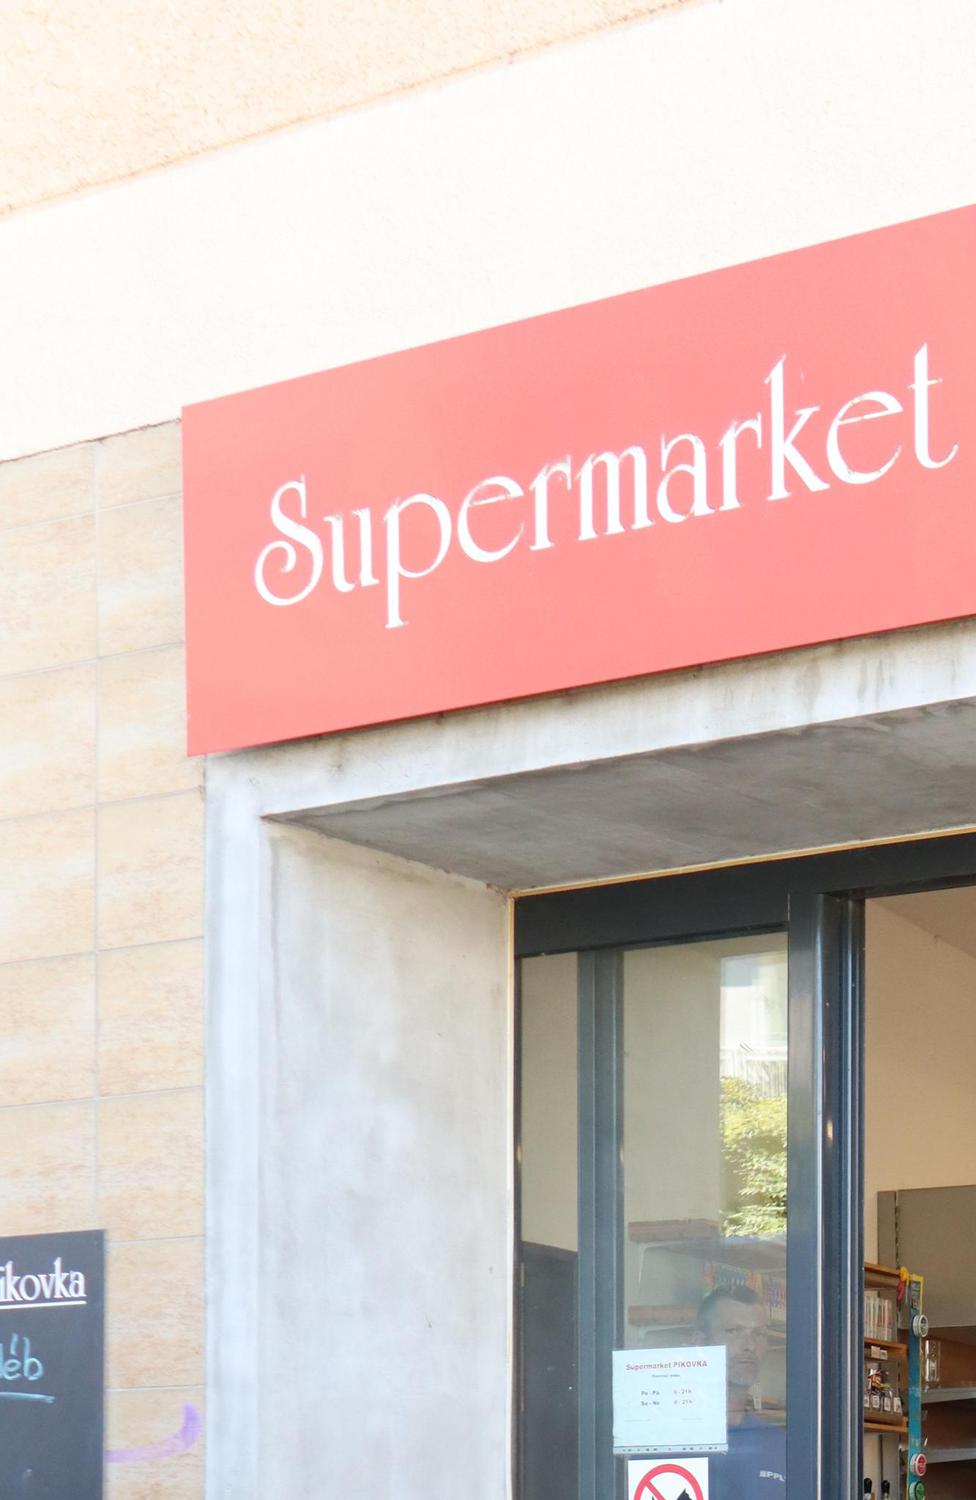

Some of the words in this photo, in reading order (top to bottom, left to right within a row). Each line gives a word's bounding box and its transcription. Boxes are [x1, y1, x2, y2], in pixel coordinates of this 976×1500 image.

[253, 341, 959, 630] Supermarket
[626, 1362, 671, 1371] Supermarket
[673, 1360, 708, 1368] PIKOVKA
